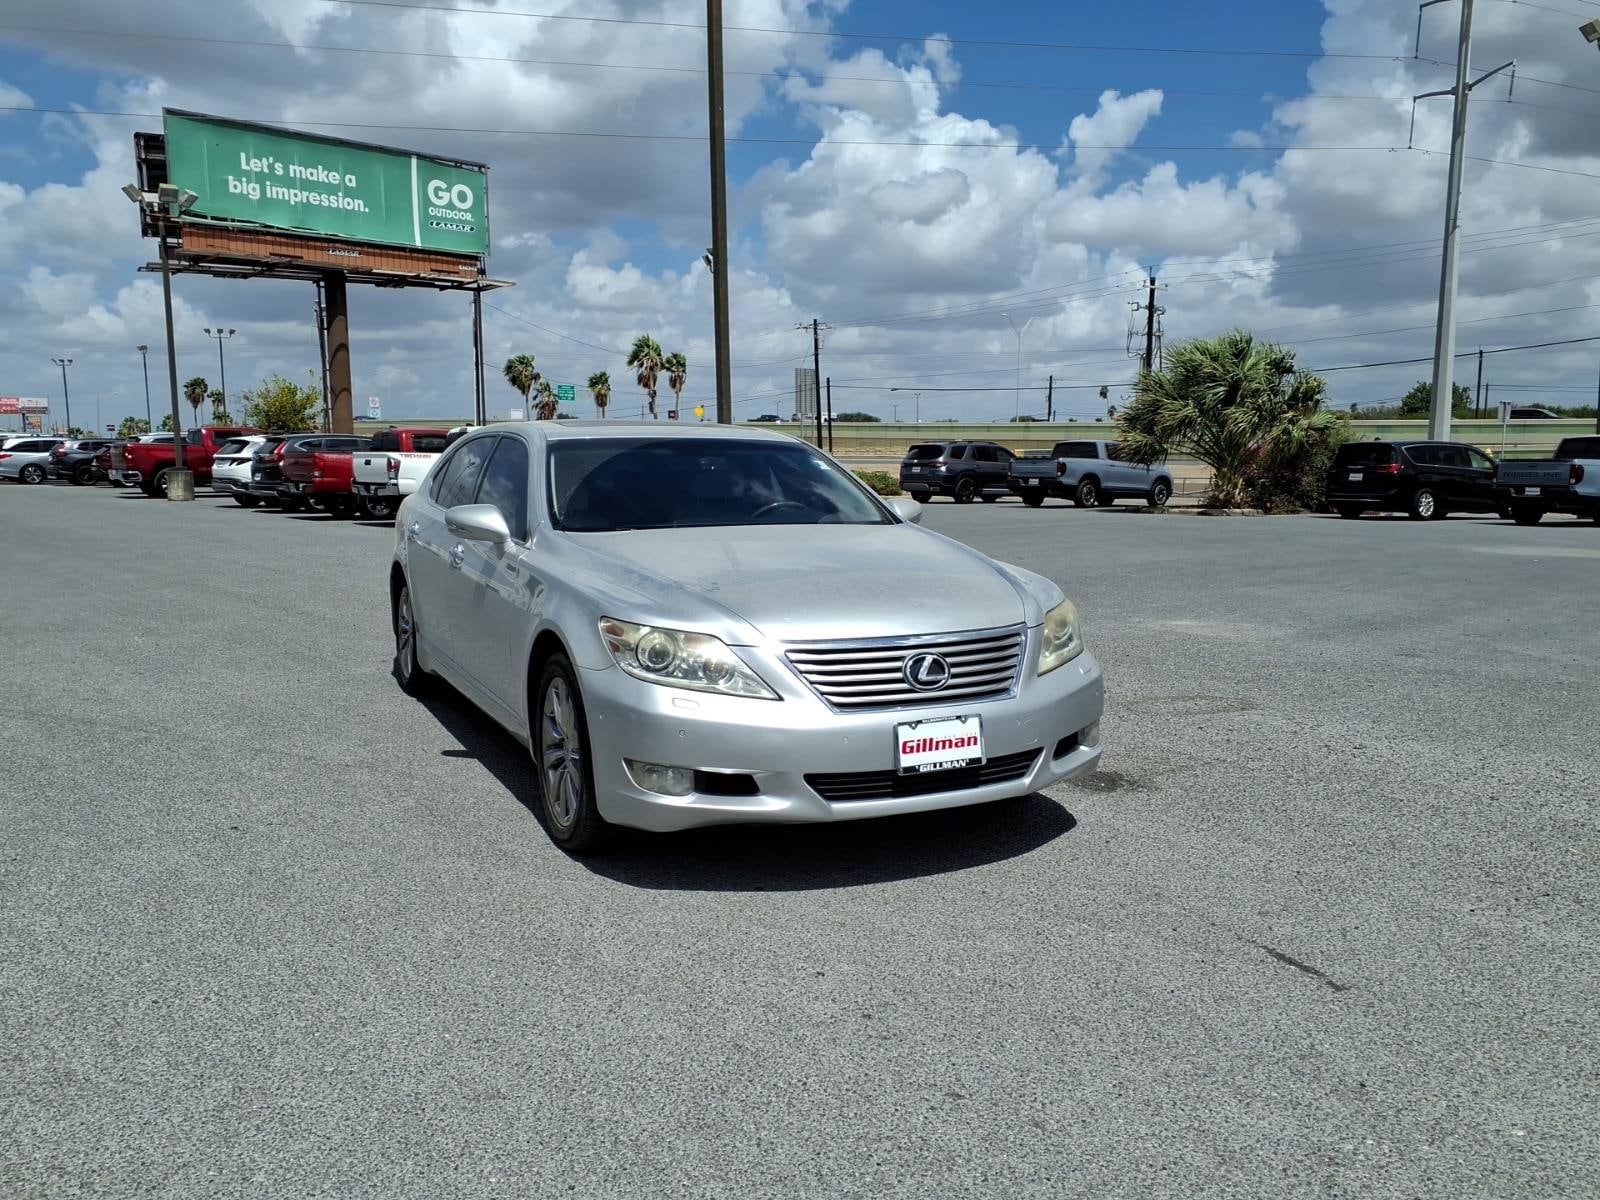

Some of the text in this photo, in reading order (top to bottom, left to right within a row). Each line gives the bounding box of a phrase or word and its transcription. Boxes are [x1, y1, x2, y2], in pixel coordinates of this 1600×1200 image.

[240, 152, 357, 188] Let's make a
[228, 175, 369, 213] big impression.
[427, 179, 474, 210] GO
[432, 221, 471, 232] LAMAR
[901, 735, 978, 755] Gillman
[919, 759, 967, 773] GILLMAN
